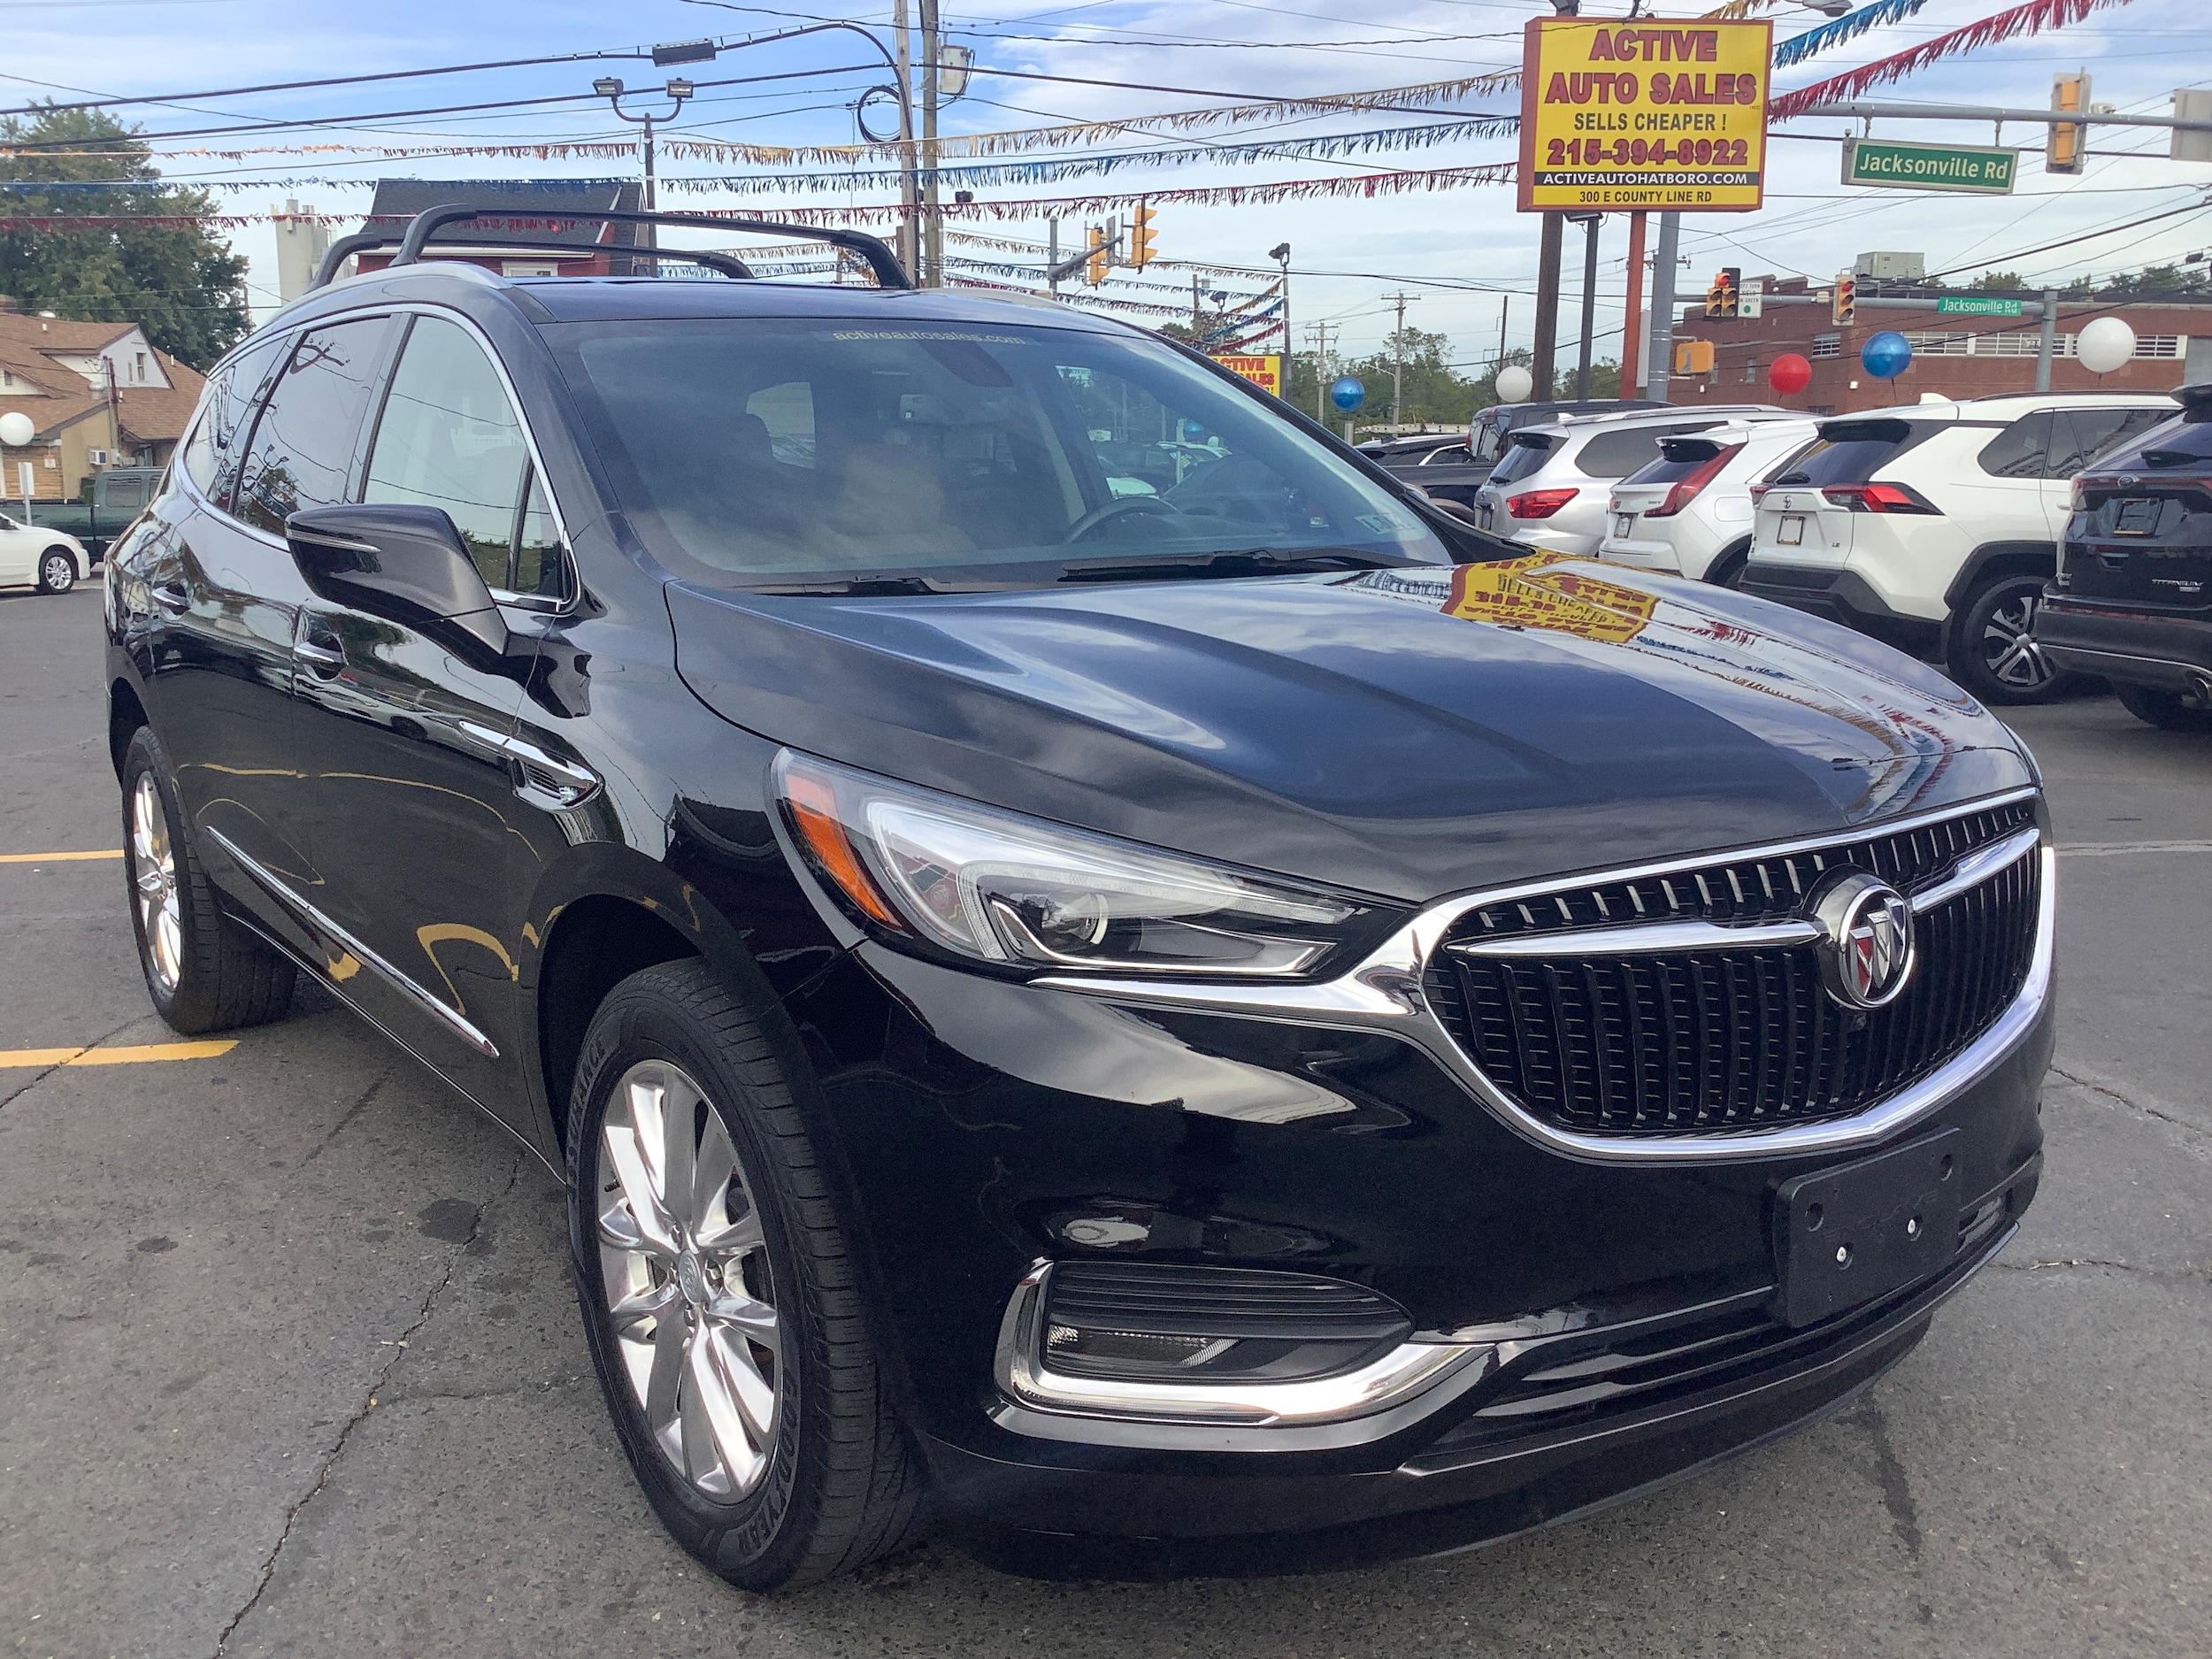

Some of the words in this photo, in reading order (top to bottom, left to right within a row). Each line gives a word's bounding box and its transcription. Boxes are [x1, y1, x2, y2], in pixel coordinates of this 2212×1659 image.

[1588, 29, 1717, 61] ACTIVE
[1544, 73, 1638, 104] AUTO
[1649, 73, 1757, 104] SALES
[1574, 113, 1627, 131] SELLS
[1634, 113, 1715, 130] CHEAPER
[1547, 138, 1748, 165] 215-394-8922
[1859, 153, 1979, 178] Jacksonville
[1984, 161, 2008, 180] Rd
[1543, 173, 1747, 185] ACTIVEAUTOHATBORO.COM
[1579, 191, 1600, 203] 300
[1603, 192, 1610, 203] E
[1614, 191, 1663, 203] COUNTY
[1666, 192, 1694, 203] LINE
[1697, 192, 1712, 203] RD
[1943, 299, 2003, 312] Jacksonville
[2005, 301, 2017, 313] Rd
[833, 330, 1026, 345] activeautosales.com
[1213, 357, 1266, 372] CTIVE
[1240, 373, 1275, 386] ALES
